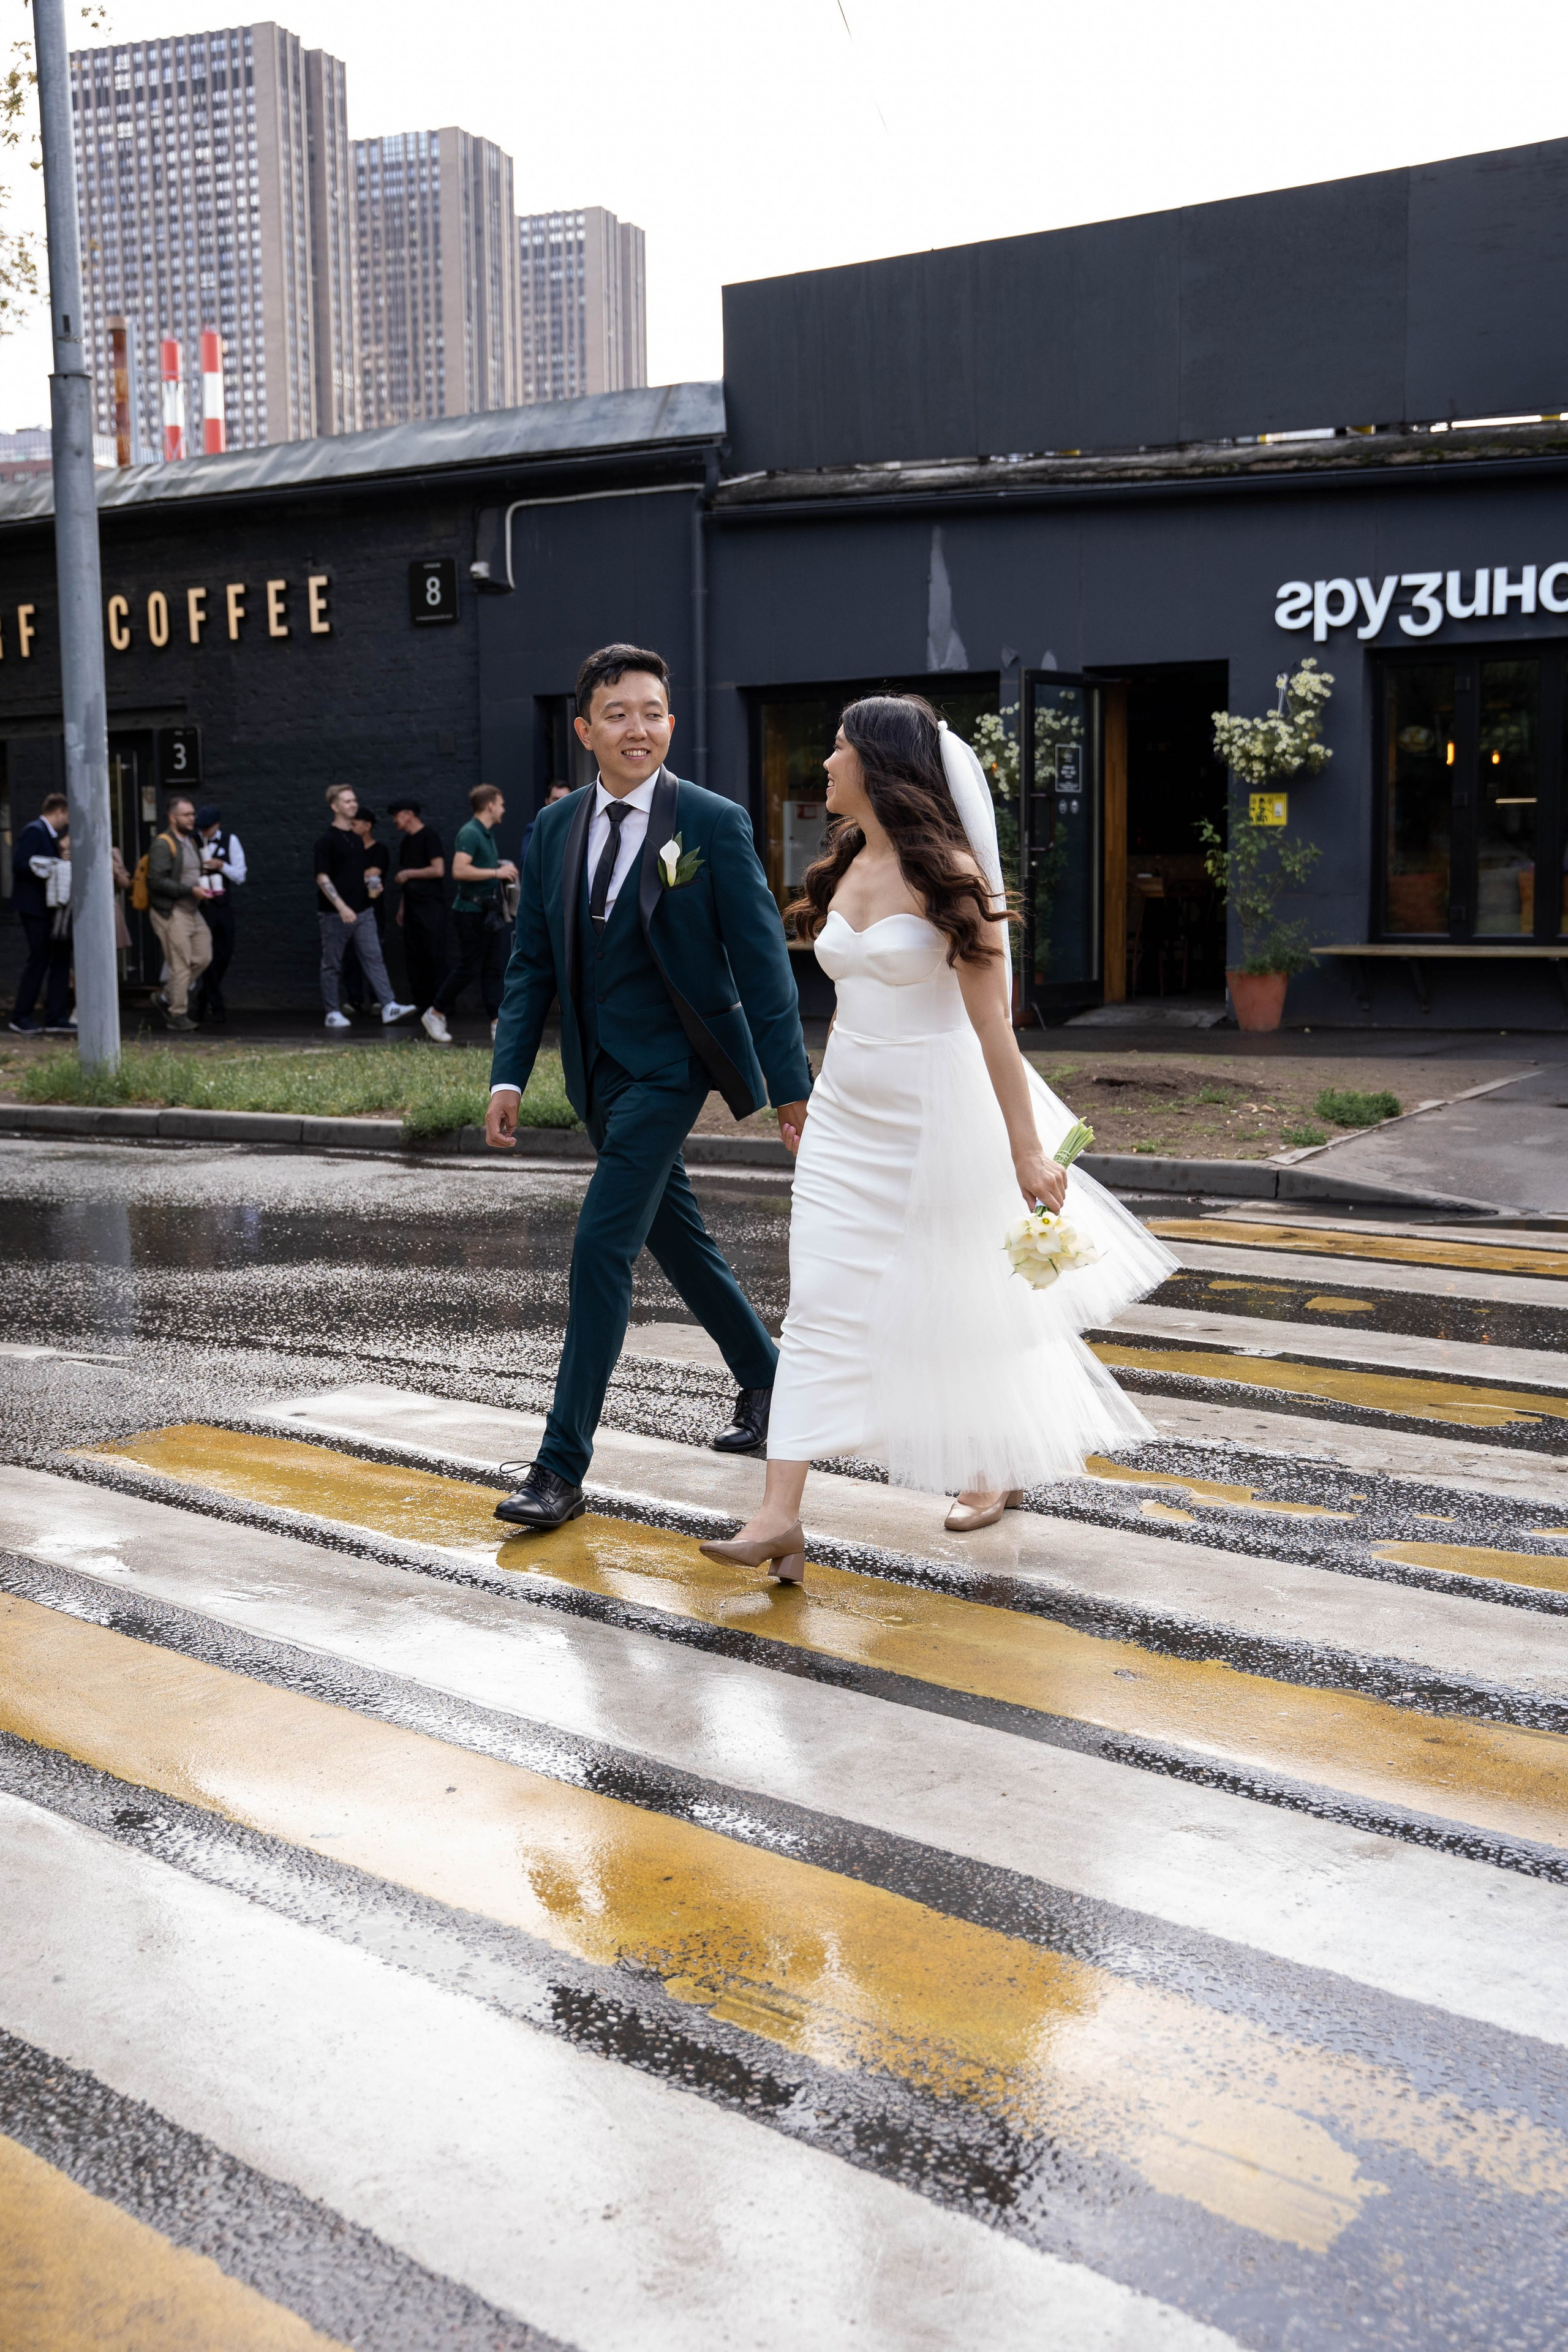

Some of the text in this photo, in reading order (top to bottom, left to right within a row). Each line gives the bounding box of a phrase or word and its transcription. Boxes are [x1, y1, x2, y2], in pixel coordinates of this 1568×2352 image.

[426, 576, 442, 606] 8
[0, 575, 330, 659] F COFFEE
[173, 743, 187, 770] 3
